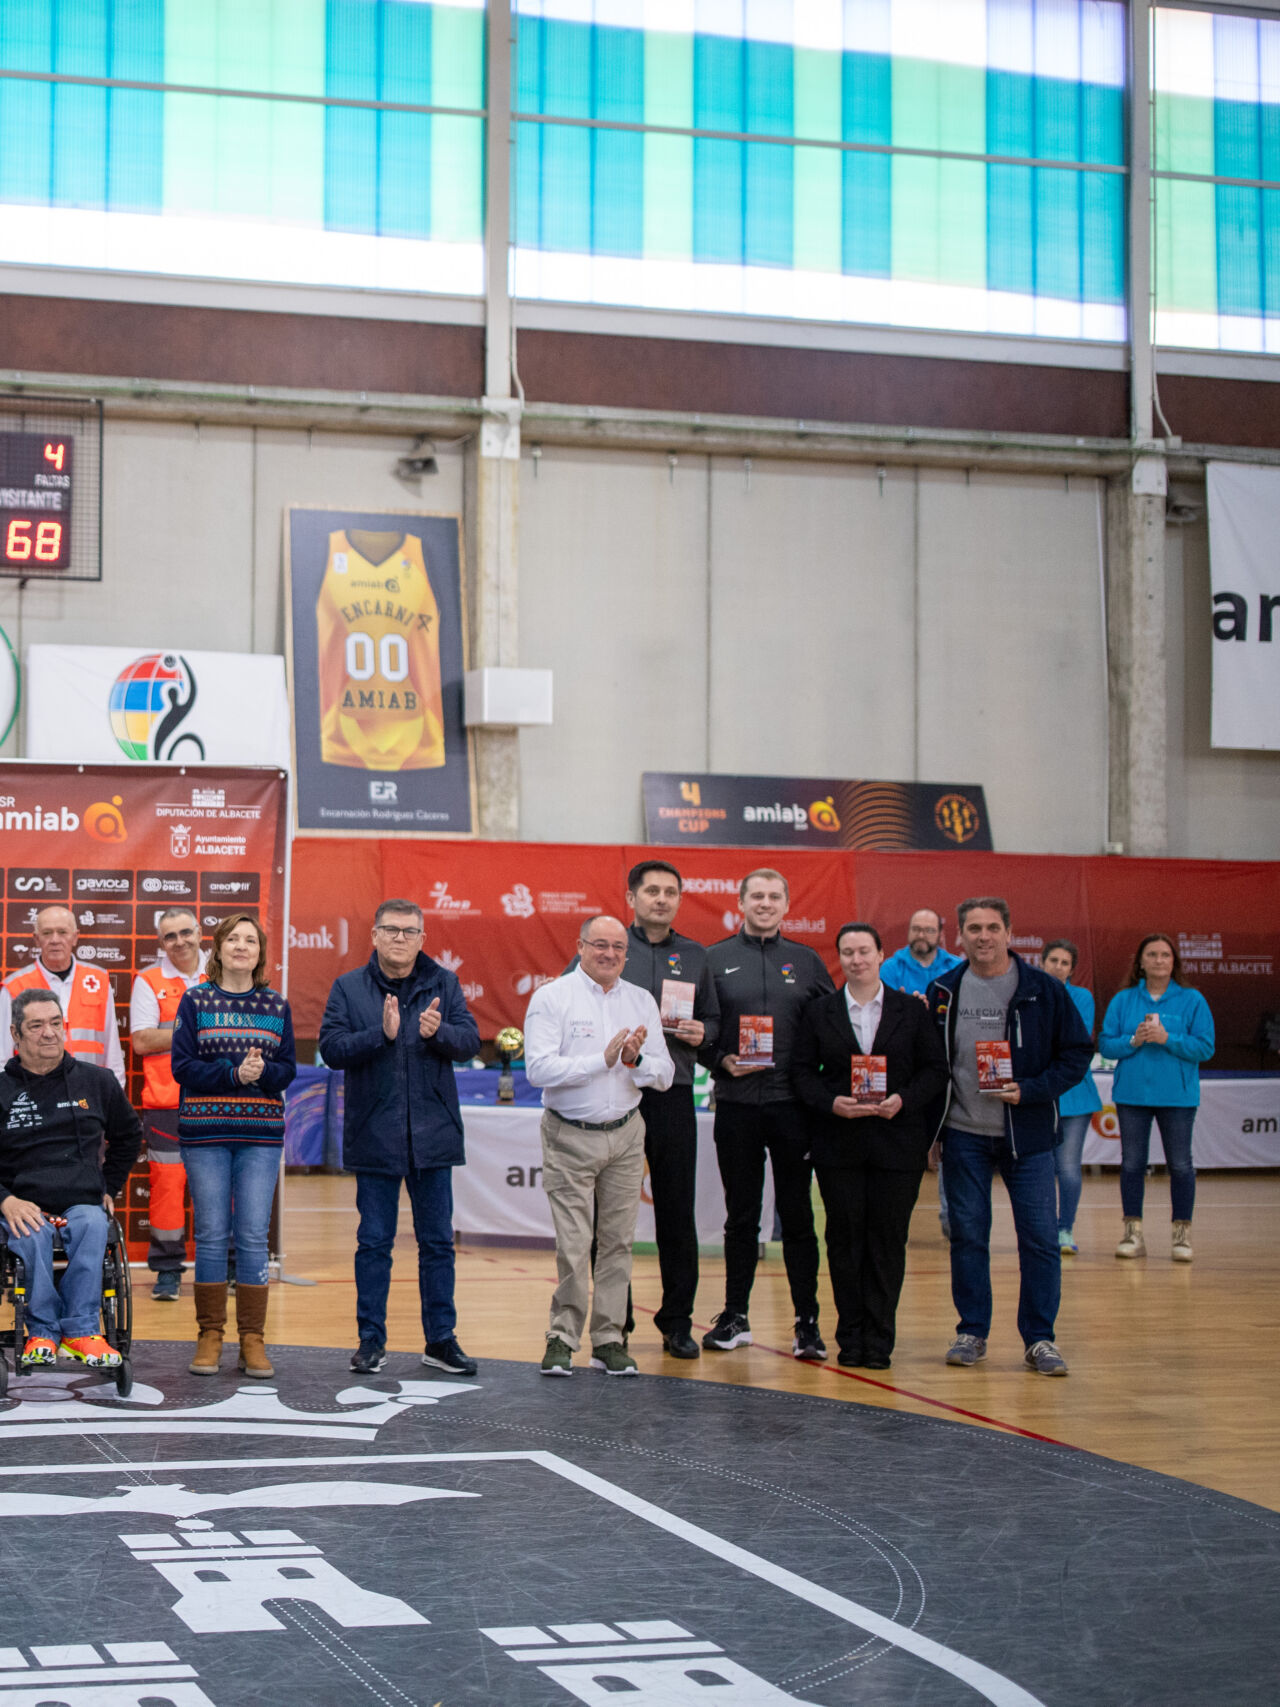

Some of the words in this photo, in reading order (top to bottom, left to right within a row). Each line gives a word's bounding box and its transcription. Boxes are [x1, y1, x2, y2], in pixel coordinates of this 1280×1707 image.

[45, 443, 64, 470] 4
[34, 474, 70, 488] FALTAS
[6, 520, 62, 560] 68
[341, 599, 414, 627] ENCARNI
[345, 632, 409, 682] 00
[342, 689, 418, 710] AMIAB
[155, 807, 205, 818] DIPUTACIÓN
[207, 809, 218, 818] DE
[219, 809, 262, 820] ALBACETE
[320, 807, 370, 820] Encarnación
[658, 806, 727, 820] CHAMPIONS
[743, 803, 808, 824] amiab
[678, 819, 710, 833] CUP
[195, 833, 246, 845] Ayuntamiento
[195, 845, 246, 856] ALBACETE
[76, 878, 130, 891] gaviota
[682, 878, 743, 894] DECATHLO
[1218, 962, 1273, 975] ALBACETE
